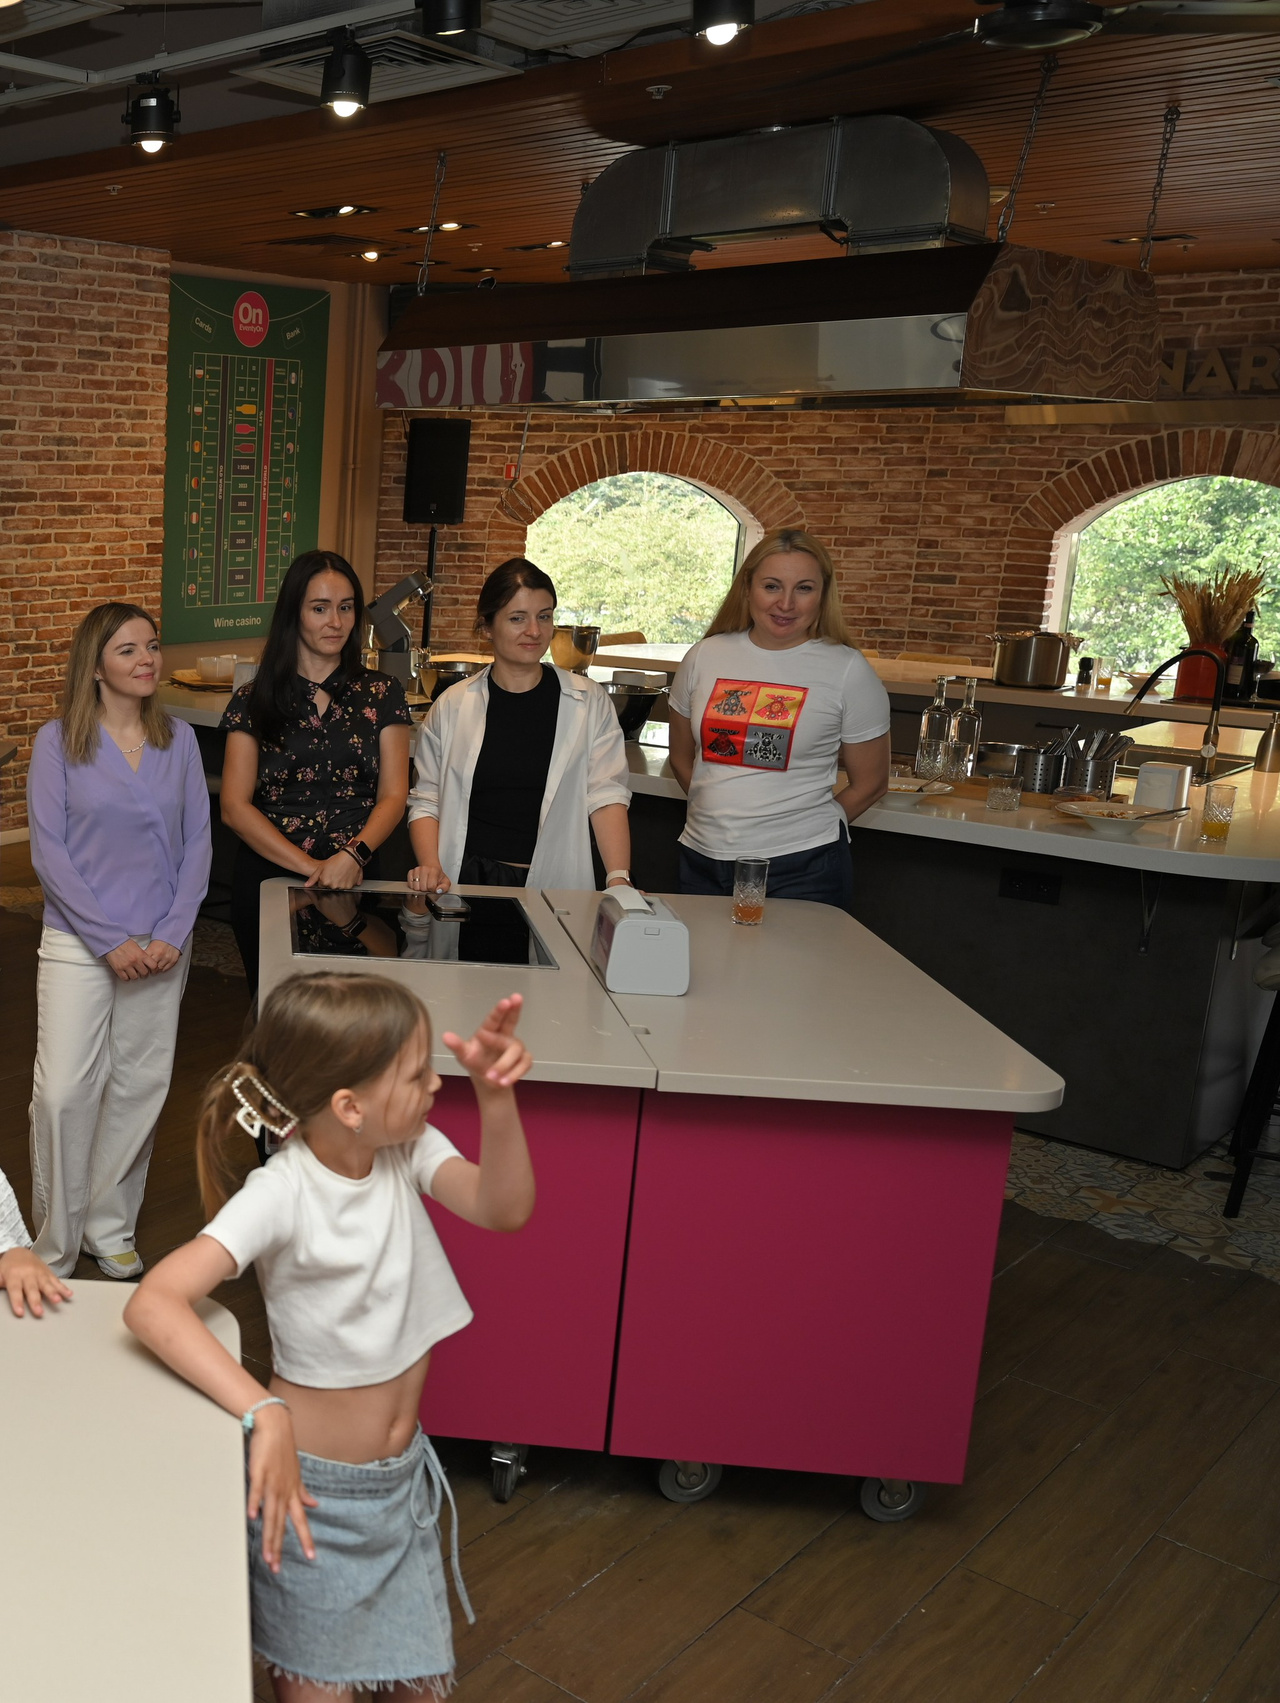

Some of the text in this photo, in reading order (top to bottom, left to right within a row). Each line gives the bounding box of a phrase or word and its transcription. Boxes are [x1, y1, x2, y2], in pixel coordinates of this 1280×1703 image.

[238, 302, 263, 325] On
[195, 316, 212, 334] Cards
[285, 327, 301, 341] Bank
[213, 615, 262, 628] Wine casino
